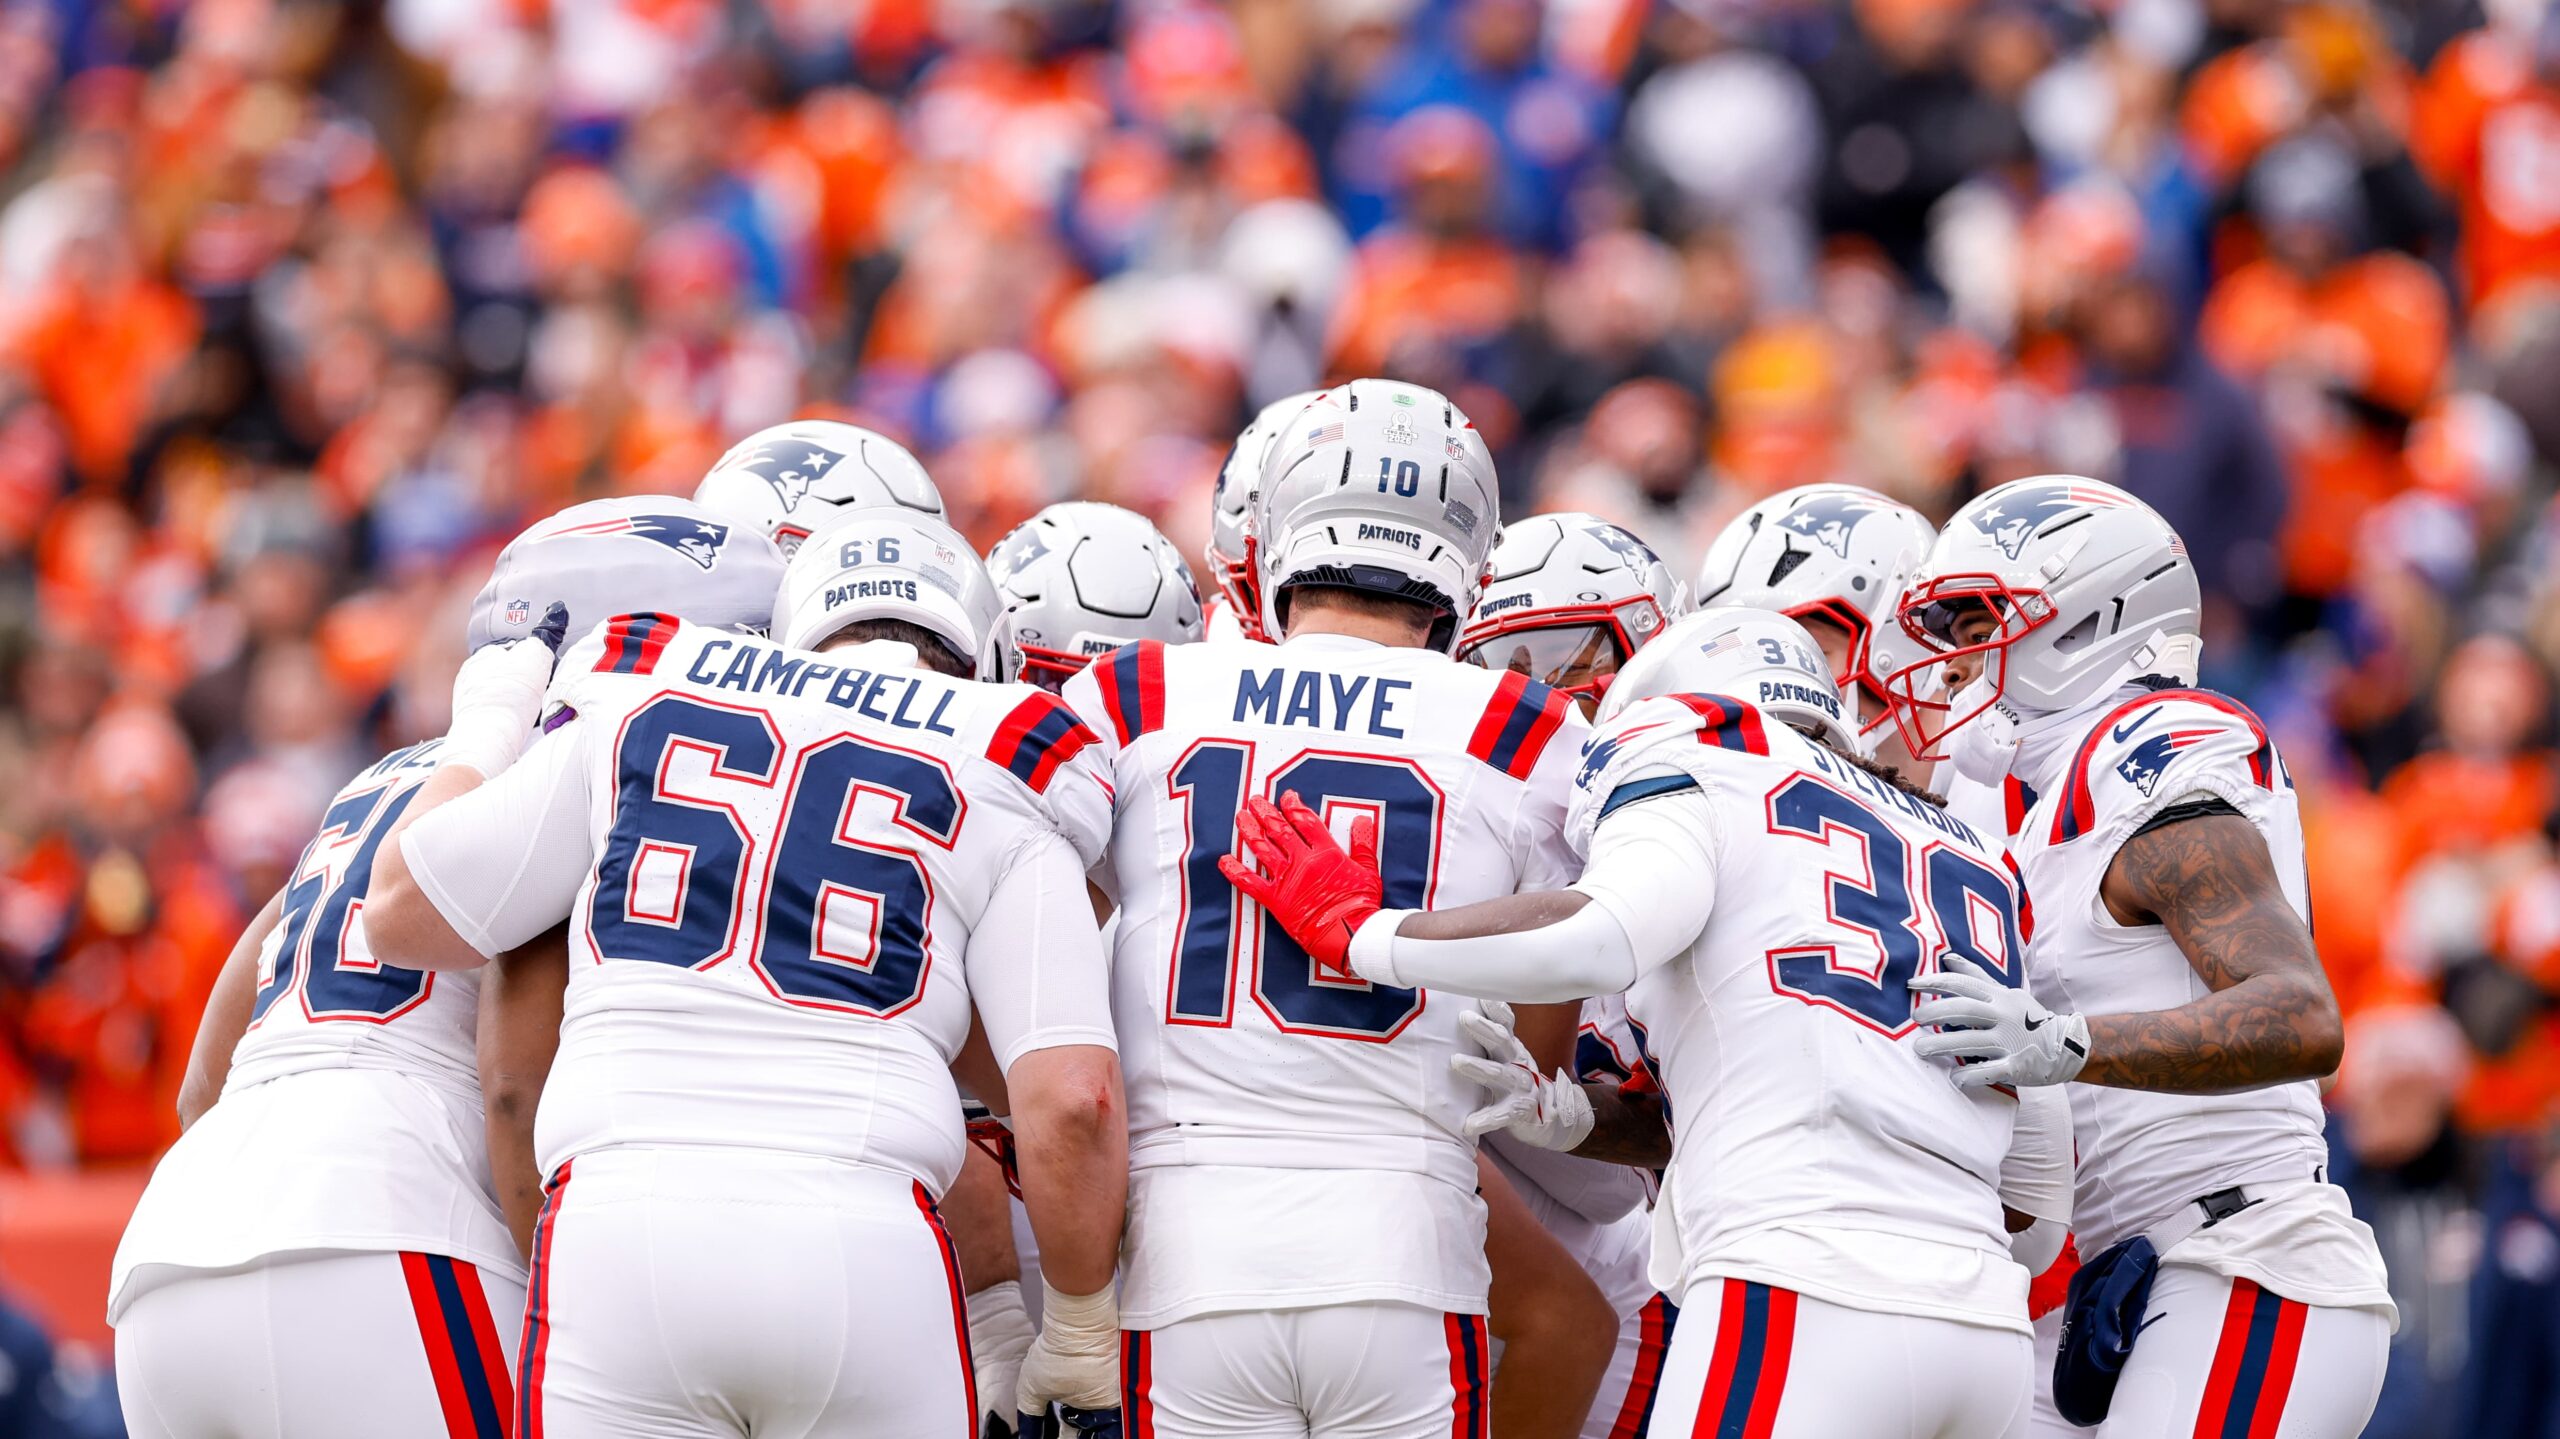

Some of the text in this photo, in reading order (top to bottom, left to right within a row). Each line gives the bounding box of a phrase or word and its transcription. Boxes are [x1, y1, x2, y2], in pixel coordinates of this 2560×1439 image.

[1446, 443, 1463, 459] NFL
[1377, 456, 1421, 498] 10
[840, 537, 900, 569] 66
[1358, 523, 1421, 550] PATRIOTS
[824, 580, 917, 611] PATRIOTS
[1479, 593, 1533, 620] PATRIOTS
[506, 610, 526, 622] NFL
[685, 640, 957, 737] CAMPBELL
[1232, 668, 1413, 739] MAYE
[1759, 682, 1841, 720] PATRIOTS
[585, 689, 969, 1021] 66
[1165, 736, 1446, 1044] 10
